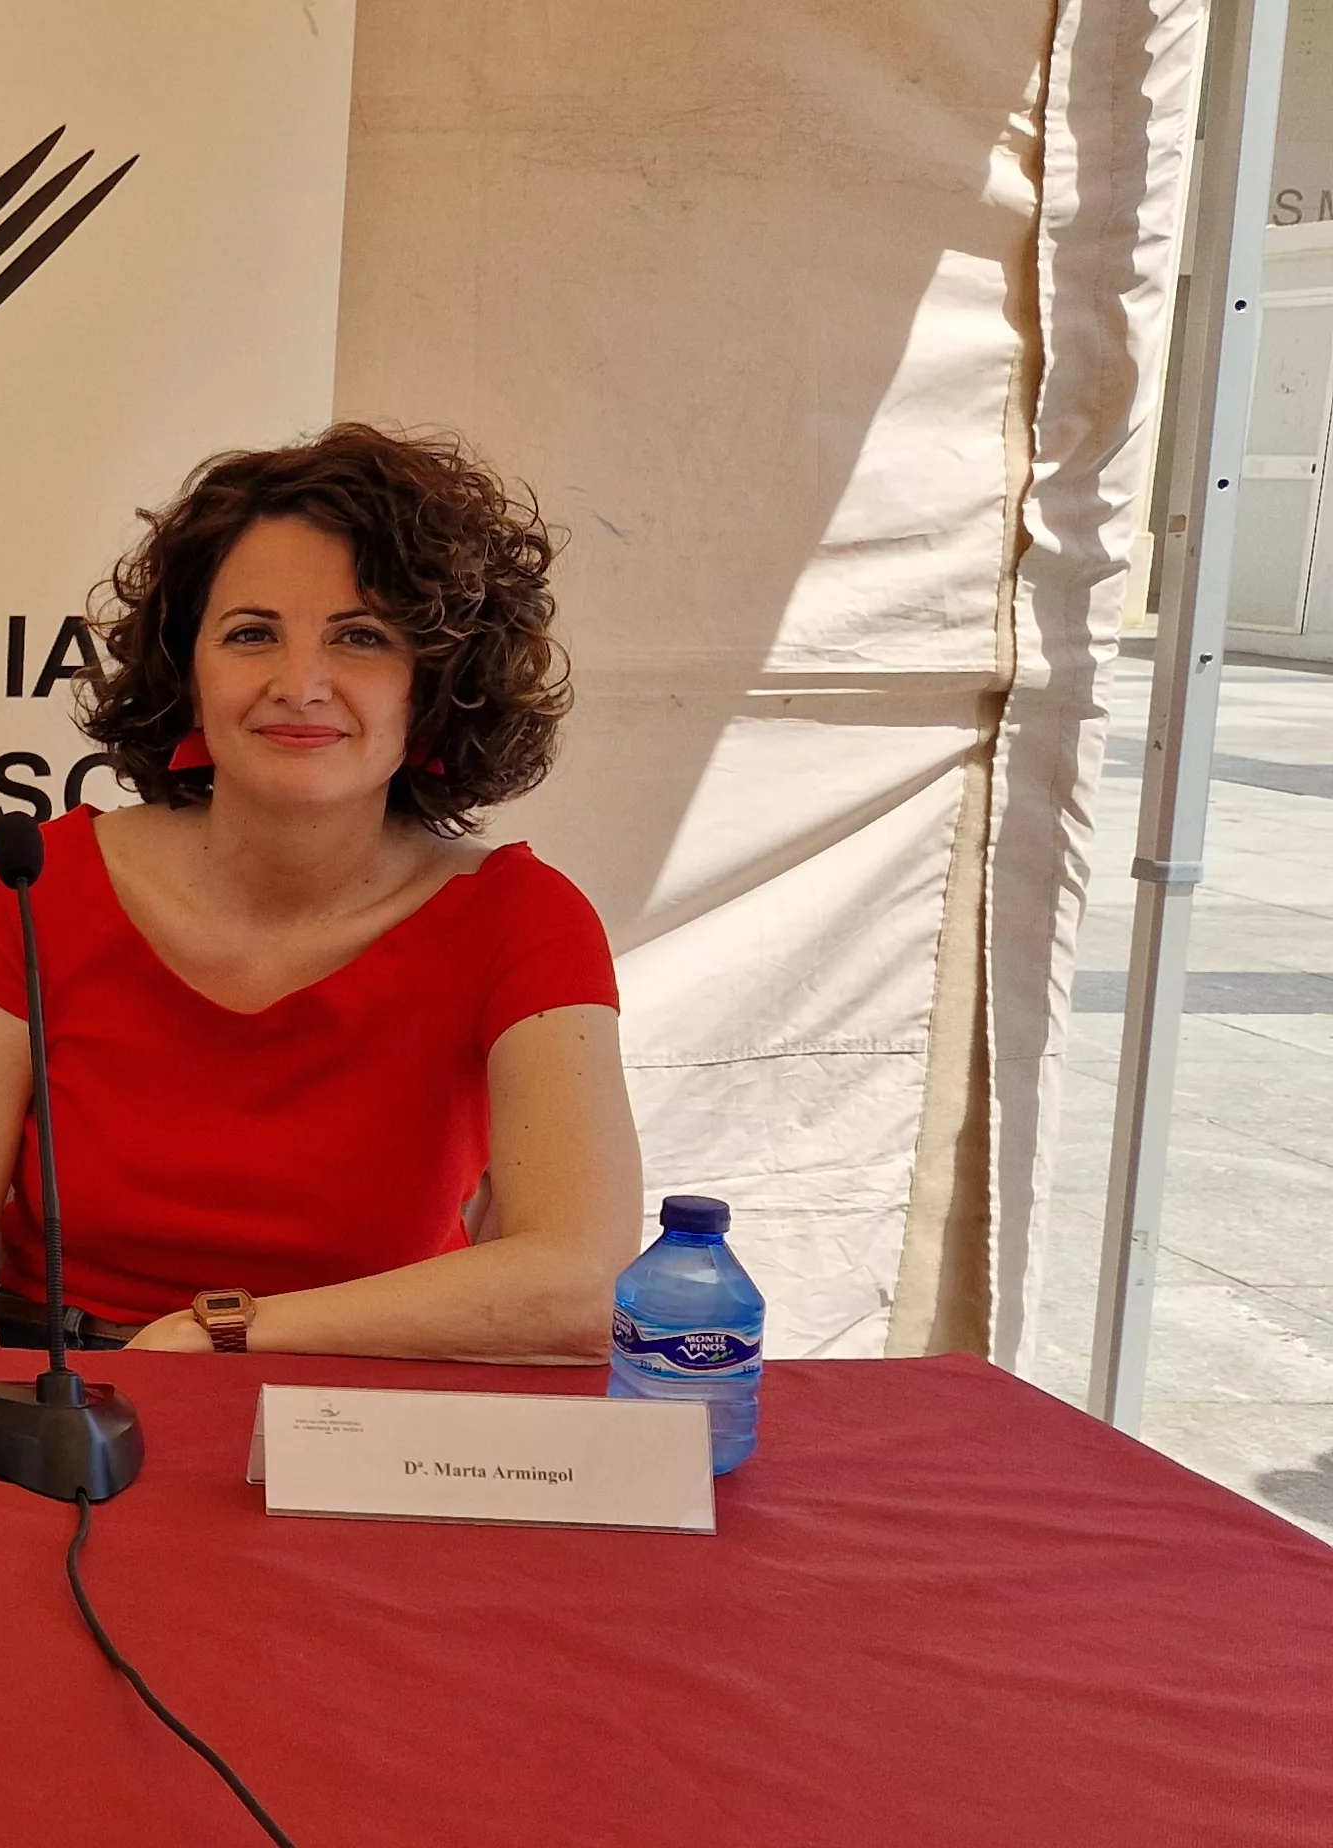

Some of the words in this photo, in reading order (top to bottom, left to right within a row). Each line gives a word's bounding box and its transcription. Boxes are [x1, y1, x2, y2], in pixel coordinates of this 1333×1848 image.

[689, 1343, 728, 1352] PINOS
[434, 1462, 487, 1479] Marta
[492, 1465, 574, 1485] Armingol
